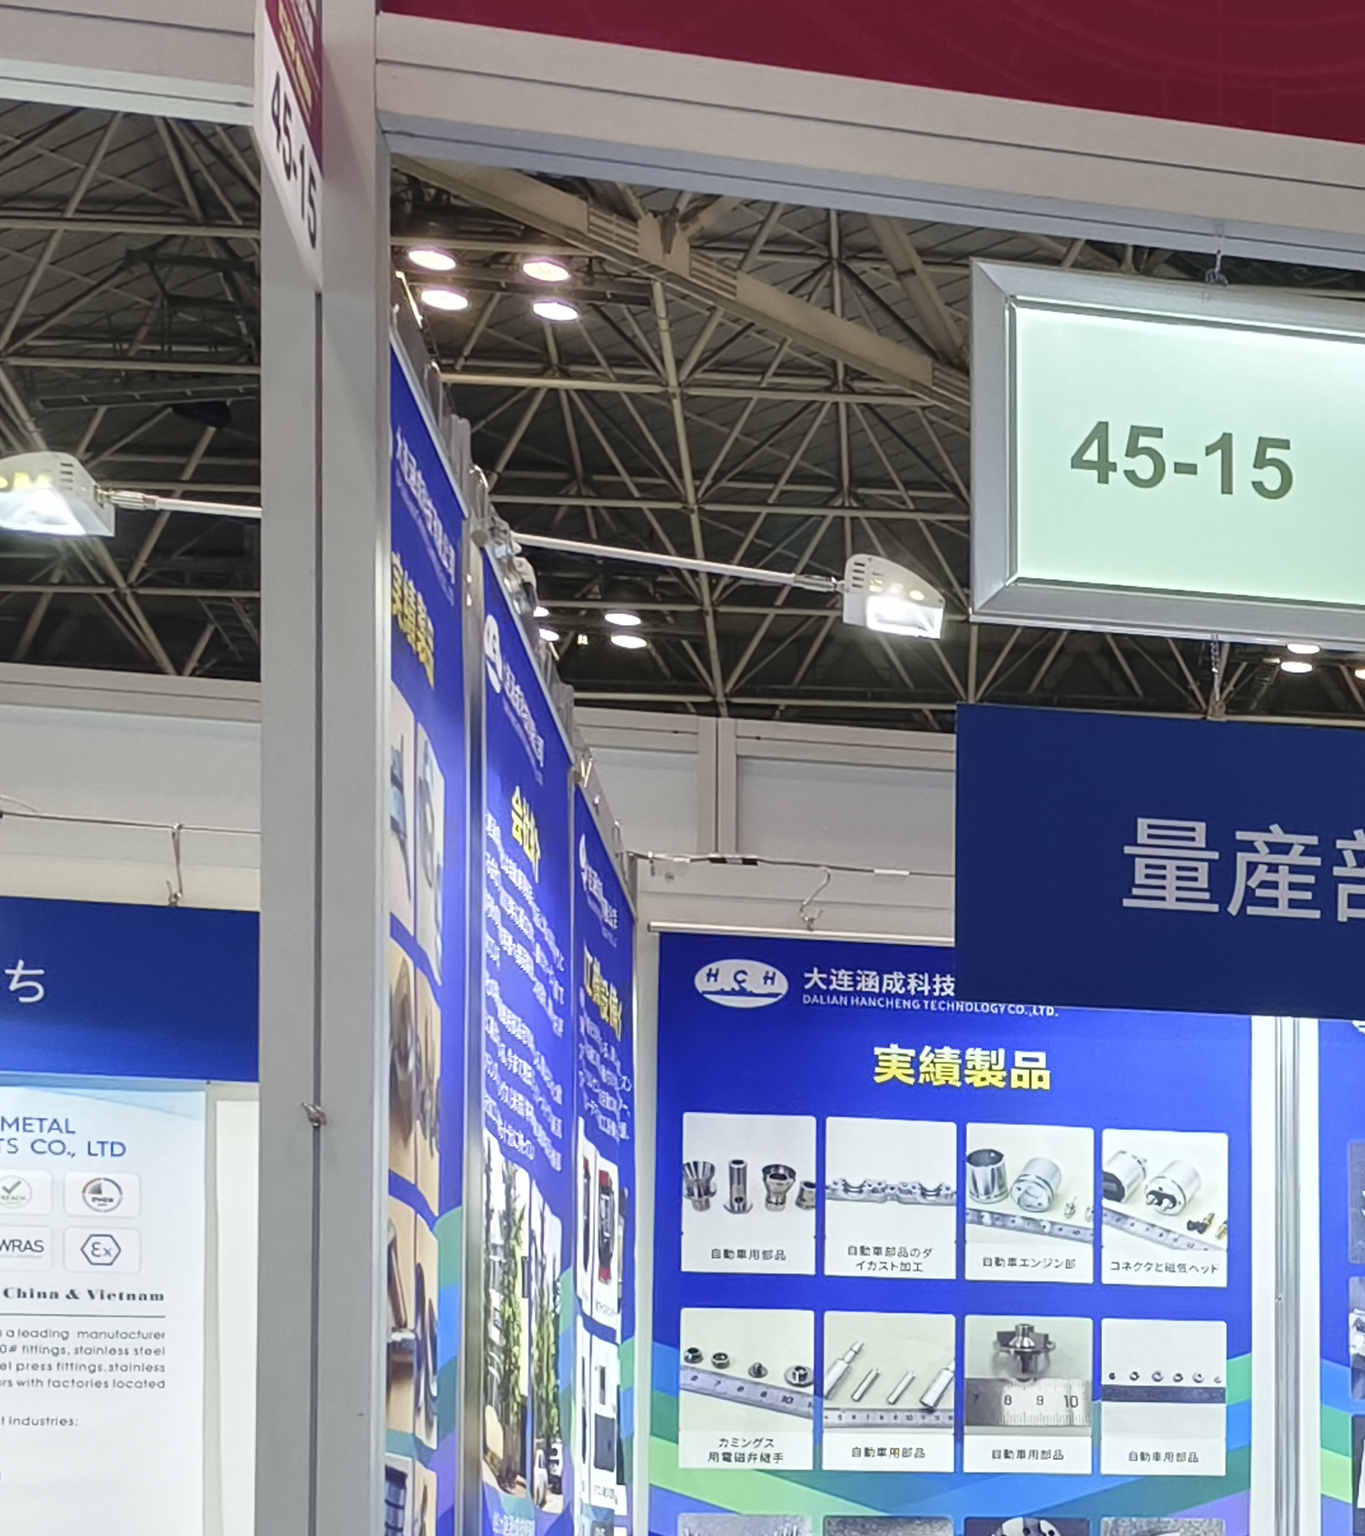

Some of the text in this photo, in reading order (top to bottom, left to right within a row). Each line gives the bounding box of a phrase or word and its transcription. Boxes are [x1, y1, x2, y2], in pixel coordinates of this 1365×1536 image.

[271, 70, 317, 250] 45-15
[1070, 420, 1294, 501] 45-15
[5, 960, 45, 1003] ち
[803, 967, 956, 998] 大连涵成科技
[802, 994, 848, 1007] DALIAN
[850, 996, 921, 1010] HANCHENG
[872, 1042, 1051, 1090] 実績製品
[0, 1116, 76, 1134] METAL
[87, 1141, 127, 1157] LTD
[711, 1248, 786, 1261] 自動車用部品
[855, 1260, 924, 1273] イカスト加工
[3, 1287, 165, 1301] China & Vietnam
[6, 1328, 165, 1340] a leading manufacturer
[73, 1345, 129, 1356] stainless
[133, 1345, 165, 1356] steel
[16, 1362, 52, 1373] press
[16, 1378, 165, 1389] with factories located
[718, 1437, 775, 1449] カミングス
[851, 1447, 926, 1459] 自動車用部品
[991, 1449, 1064, 1461] 自動車用部品
[1128, 1451, 1199, 1463] 自動車用部品
